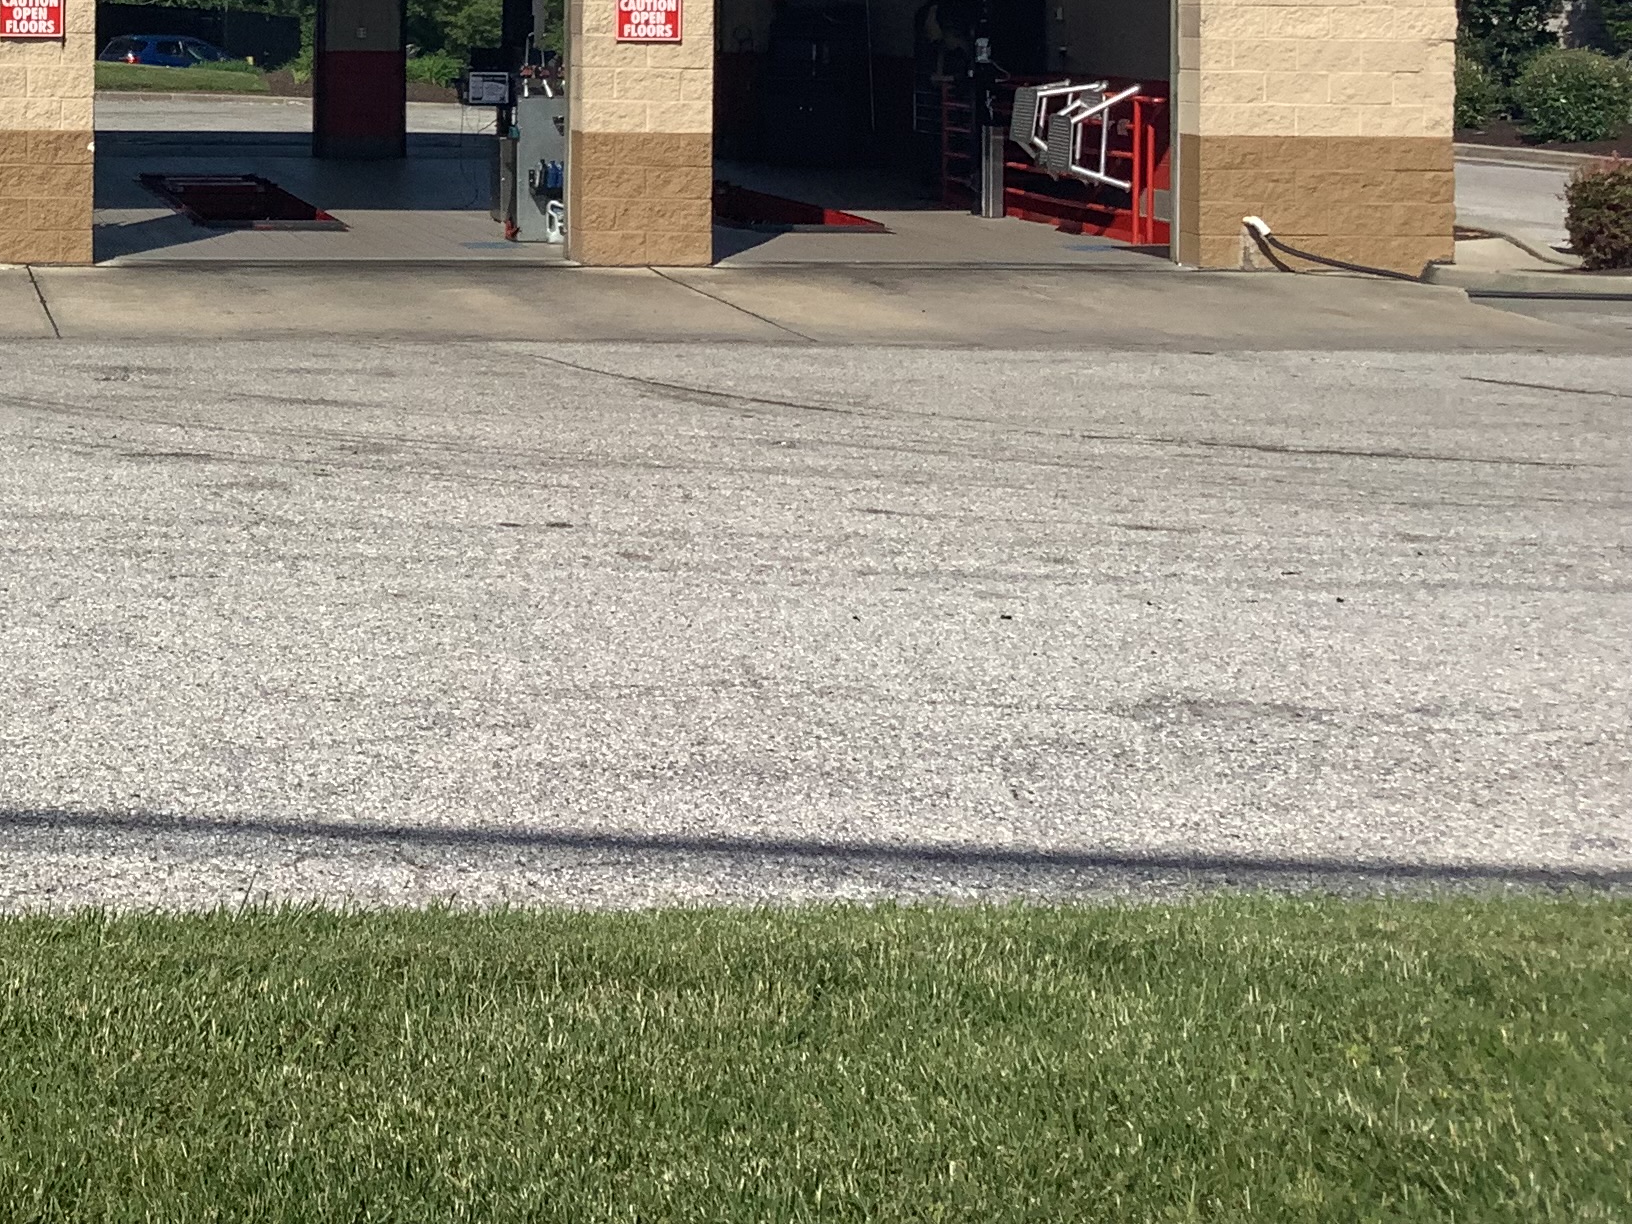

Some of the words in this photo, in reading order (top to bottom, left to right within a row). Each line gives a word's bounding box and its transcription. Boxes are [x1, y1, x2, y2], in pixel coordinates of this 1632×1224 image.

[12, 6, 48, 21] OPEN
[630, 11, 666, 25] OPEN
[5, 19, 55, 33] FLOORS
[623, 23, 673, 37] FLOORS
